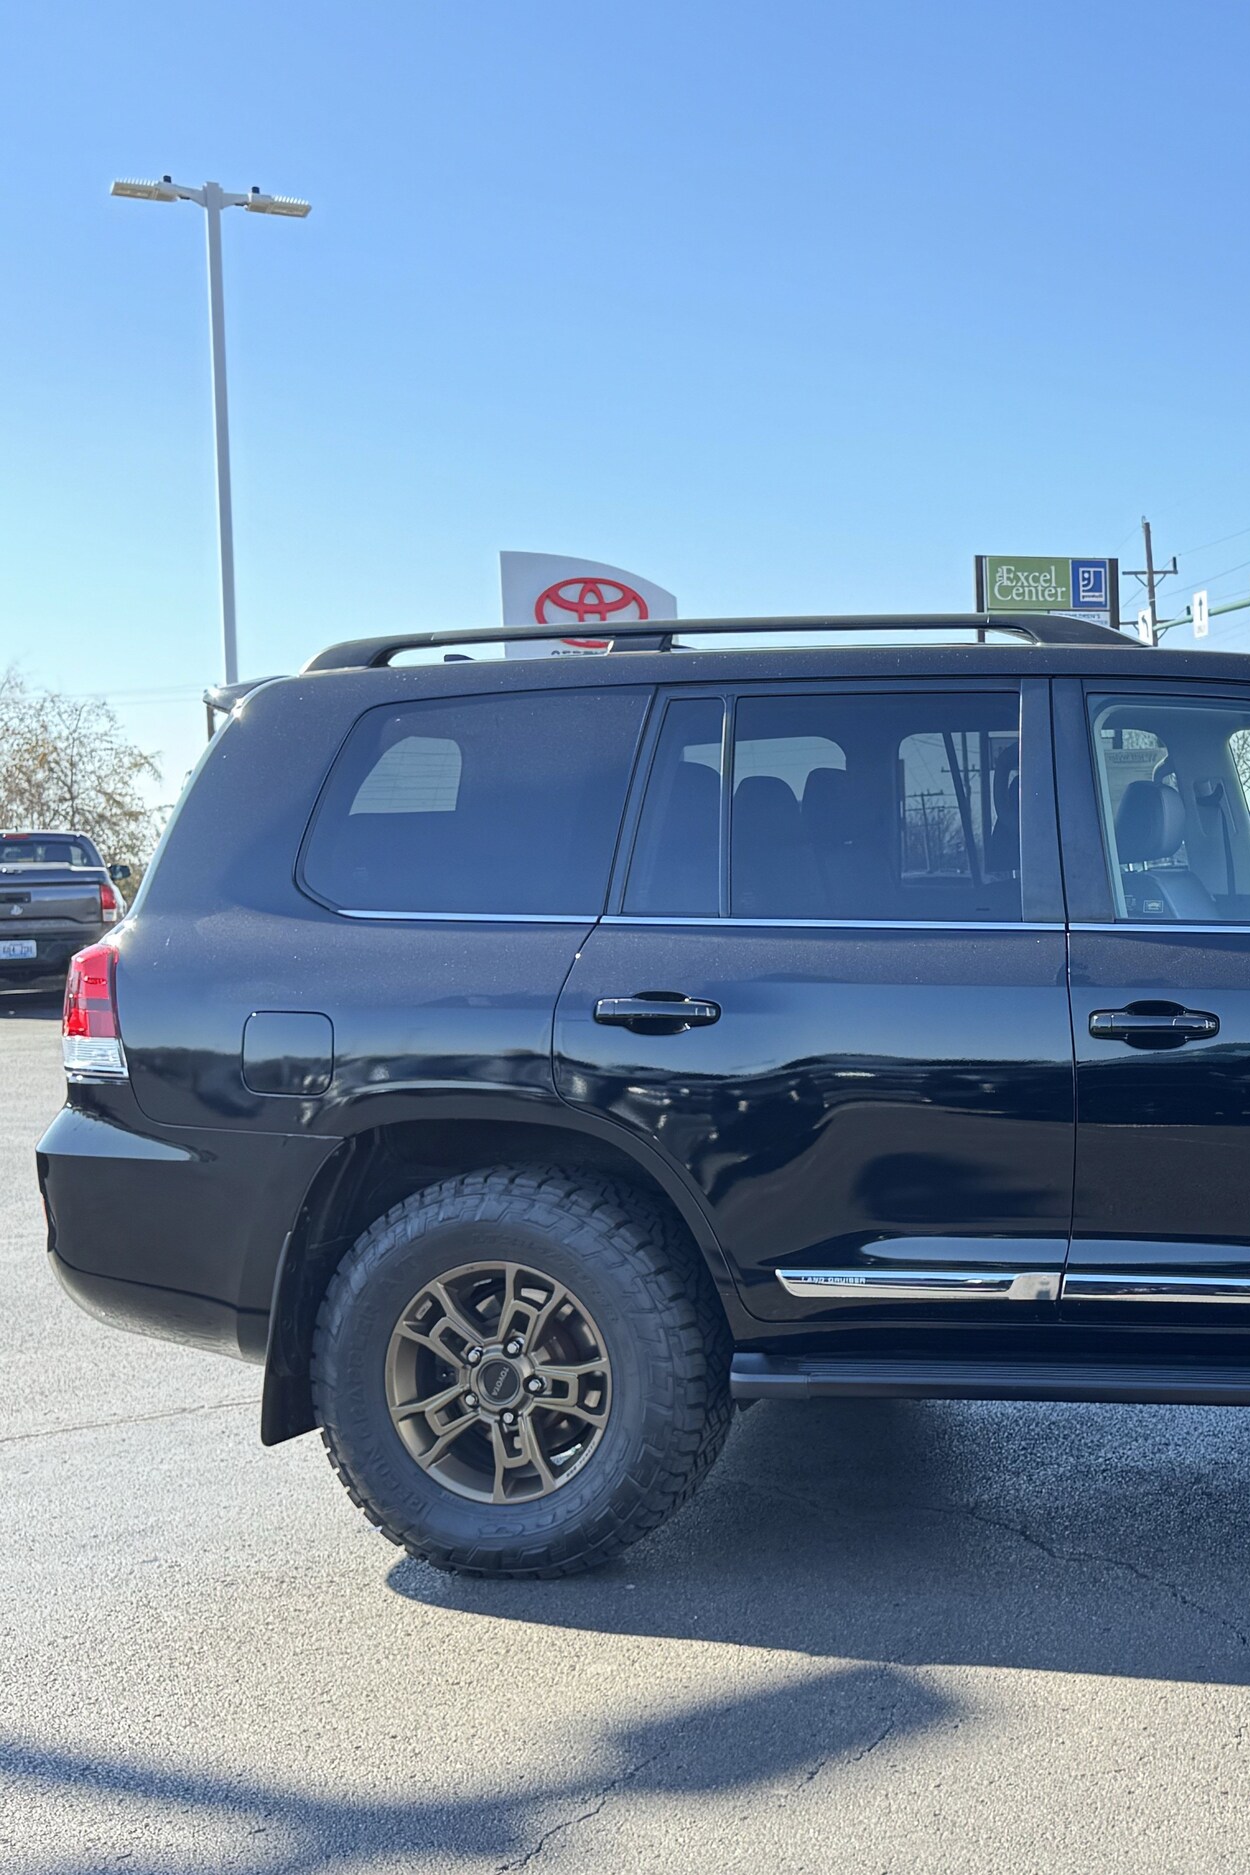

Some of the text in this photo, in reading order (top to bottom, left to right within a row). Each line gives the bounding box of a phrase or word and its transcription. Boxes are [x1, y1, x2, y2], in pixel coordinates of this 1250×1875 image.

[1001, 565, 1056, 586] Excel
[994, 581, 1066, 601] Center
[801, 1276, 825, 1284] LAND
[491, 1366, 510, 1396] TOYOTA
